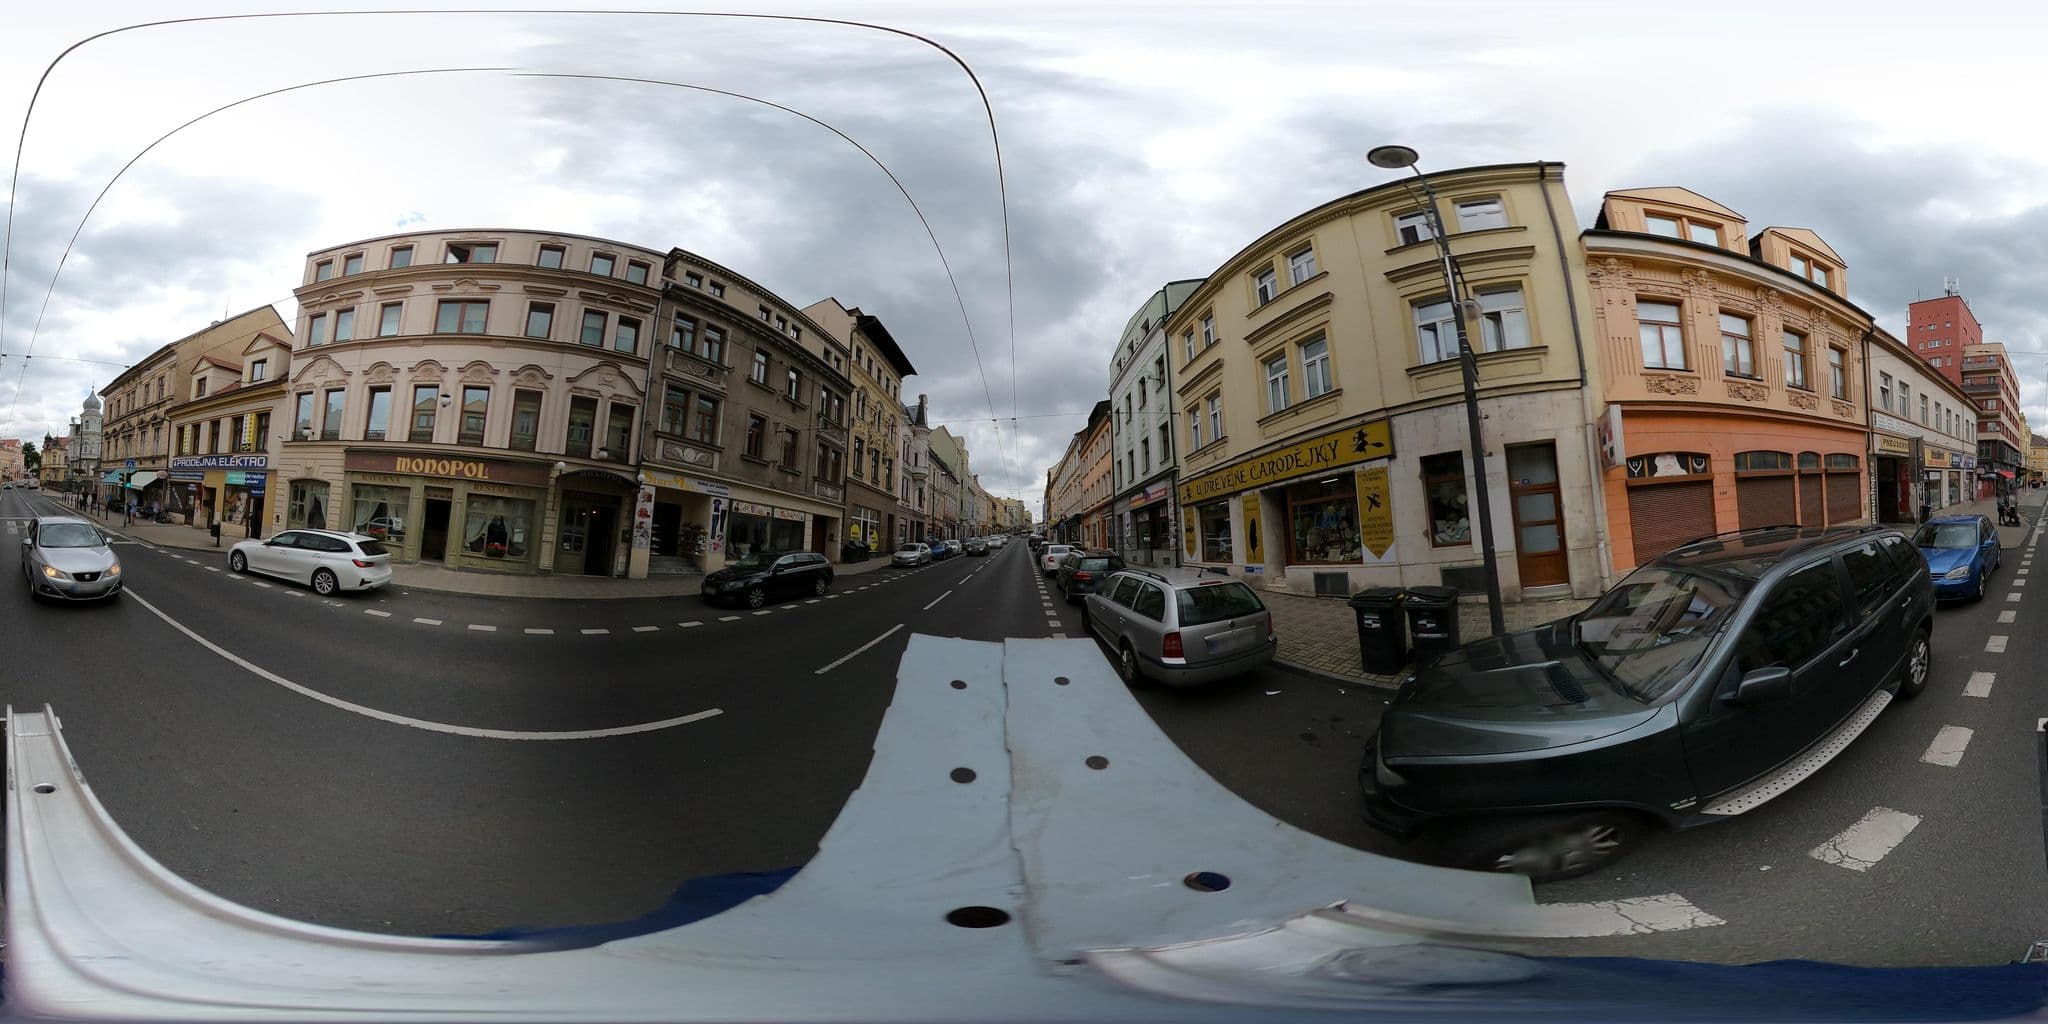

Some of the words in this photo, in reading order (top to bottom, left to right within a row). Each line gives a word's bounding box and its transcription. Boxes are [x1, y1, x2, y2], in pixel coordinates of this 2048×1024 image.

[178, 458, 218, 467] PRODEJNA
[219, 457, 266, 467] ELEKTRO
[395, 456, 489, 478] MONOPOL
[1196, 484, 1202, 496] U
[1249, 439, 1340, 480] ČARODĚJKY
[1869, 461, 1877, 525] pneushop.cz
